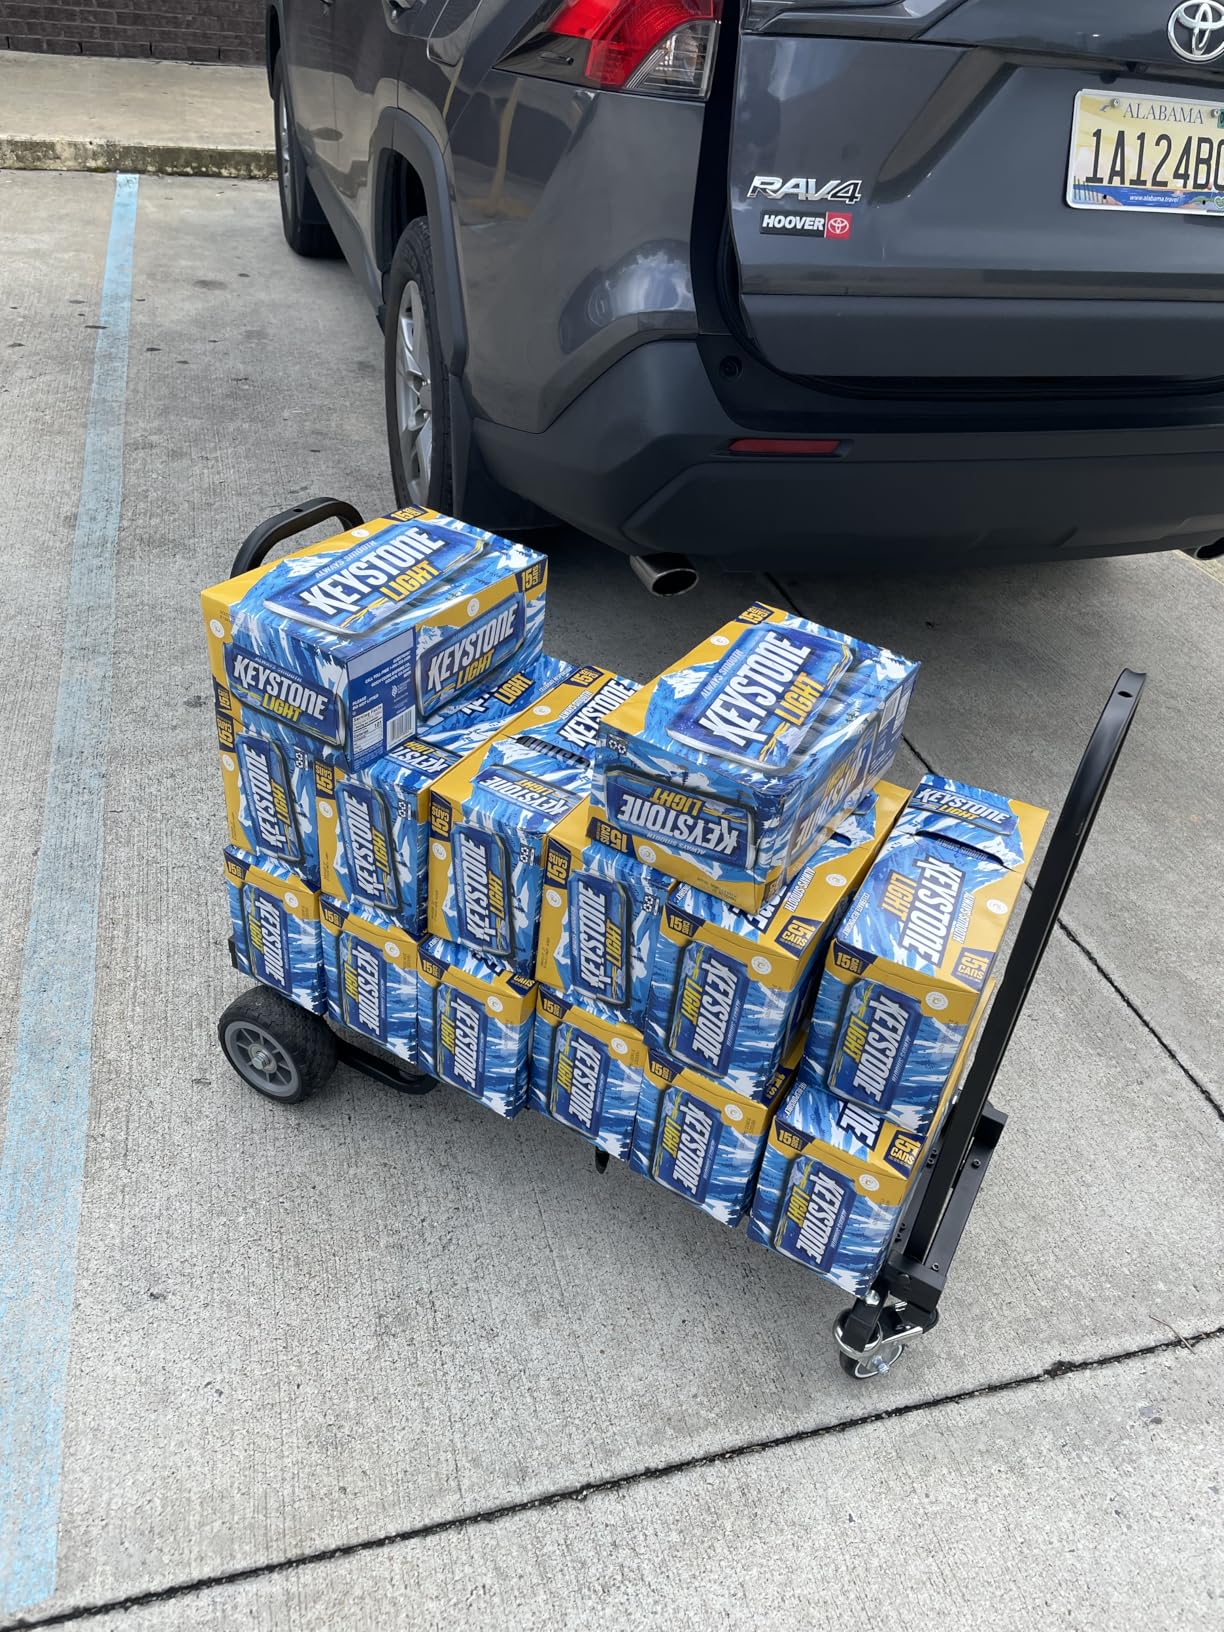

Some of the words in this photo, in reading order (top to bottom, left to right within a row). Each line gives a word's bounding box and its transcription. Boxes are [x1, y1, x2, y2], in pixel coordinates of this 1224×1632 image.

[1123, 103, 1204, 124] ALABAMA
[747, 176, 862, 204] RAV4
[762, 214, 825, 230] HOOVER
[391, 511, 415, 522] 15
[299, 527, 446, 616] KEYSTONE
[315, 558, 344, 579] ALWAYS
[344, 540, 377, 562] SMOOTH
[379, 560, 441, 602] LIGHT
[521, 570, 532, 590] 15
[738, 610, 764, 624] 15
[428, 601, 519, 692] KEYSTONE
[456, 649, 496, 688] LIGHT
[570, 674, 593, 686] 15
[700, 674, 723, 700] ALWAYS
[719, 648, 744, 676] SMOOTH
[233, 654, 329, 720] KEYSTONE
[494, 672, 534, 705] LIGHT
[698, 630, 812, 747] KEYSTONE
[774, 671, 825, 726] LIGHT
[262, 693, 302, 722] LIGHT
[559, 679, 636, 748] KEYSTONE
[218, 730, 234, 748] 15
[404, 741, 434, 755] LIGH
[316, 764, 332, 780] CANS
[388, 746, 449, 773] KEYST
[243, 743, 287, 848] KEYSTONE
[271, 779, 290, 824] LIGHT
[316, 776, 333, 796] 15
[479, 776, 570, 816] KEYSTONE
[515, 778, 554, 796] LIGHT
[650, 787, 703, 817] LIGHT
[431, 806, 450, 822] CANS
[917, 788, 1011, 824] KEYSTONE
[938, 804, 981, 820] LIGHT
[432, 820, 450, 837] 15
[610, 829, 627, 852] 15
[617, 794, 738, 854] KEYSTONE
[344, 790, 384, 897] KEYSTONE
[372, 826, 390, 874] LIGHT
[548, 852, 568, 868] CANS
[228, 860, 237, 876] 15
[548, 865, 568, 884] 15
[797, 866, 816, 890] ALWAYS
[461, 834, 496, 942] KEYSTONE
[488, 871, 505, 920] LIGHT
[882, 872, 918, 921] LIGHT
[959, 890, 976, 916] ALWAYS
[324, 908, 334, 923] 15
[670, 914, 682, 932] 15
[902, 856, 962, 964] KEYSTONE
[248, 914, 264, 955] LIGHT
[255, 896, 286, 987] KEYSTONE
[579, 881, 612, 989] KEYSTONE
[606, 918, 622, 968] LIGHT
[782, 932, 808, 947] CANS
[786, 920, 816, 940] 15
[422, 959, 432, 974] 15
[837, 952, 850, 968] 15
[958, 966, 985, 980] CANS
[960, 952, 990, 971] 15
[344, 962, 358, 1003] LIGHT
[352, 945, 380, 1036] KEYSTONE
[513, 974, 535, 988] CANS
[542, 997, 554, 1012] 15
[680, 976, 702, 1026] LIGHT
[702, 958, 738, 1066] KEYSTONE
[440, 1012, 455, 1056] LIGHT
[450, 997, 480, 1089] KEYSTONE
[843, 1014, 870, 1064] LIGHT
[868, 994, 910, 1103] KEYSTONE
[556, 1052, 574, 1094] LIGHT
[570, 1036, 602, 1129] KEYSTONE
[651, 1060, 662, 1076] 15
[662, 1115, 682, 1158] LIGHT
[680, 1102, 713, 1196] KEYSTONE
[778, 1129, 791, 1146] 15
[894, 1134, 920, 1156] 15
[890, 1146, 916, 1166] CANS
[787, 1185, 810, 1227] LIGHT
[810, 1171, 845, 1265] KEYSTONE
